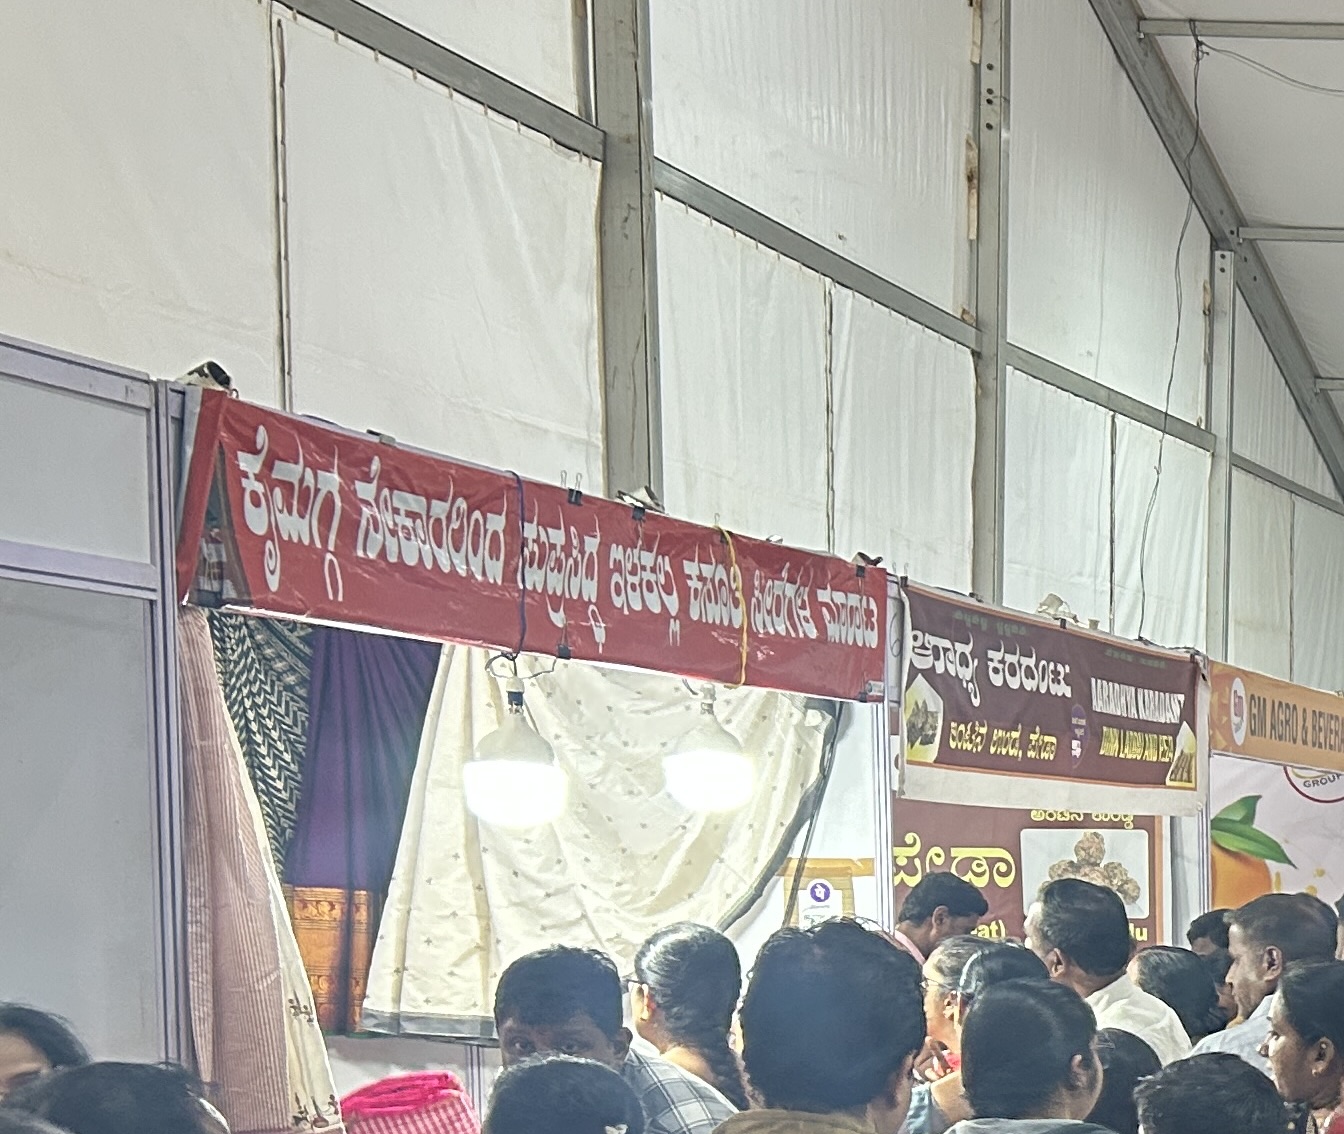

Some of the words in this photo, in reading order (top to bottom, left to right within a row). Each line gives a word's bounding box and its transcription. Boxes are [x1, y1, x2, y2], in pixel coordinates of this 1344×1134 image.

[237, 425, 343, 602] ಕೈಮಗ್ಗ
[1249, 693, 1267, 740] GM
[1270, 700, 1298, 745] AGRO
[1302, 706, 1309, 747] &
